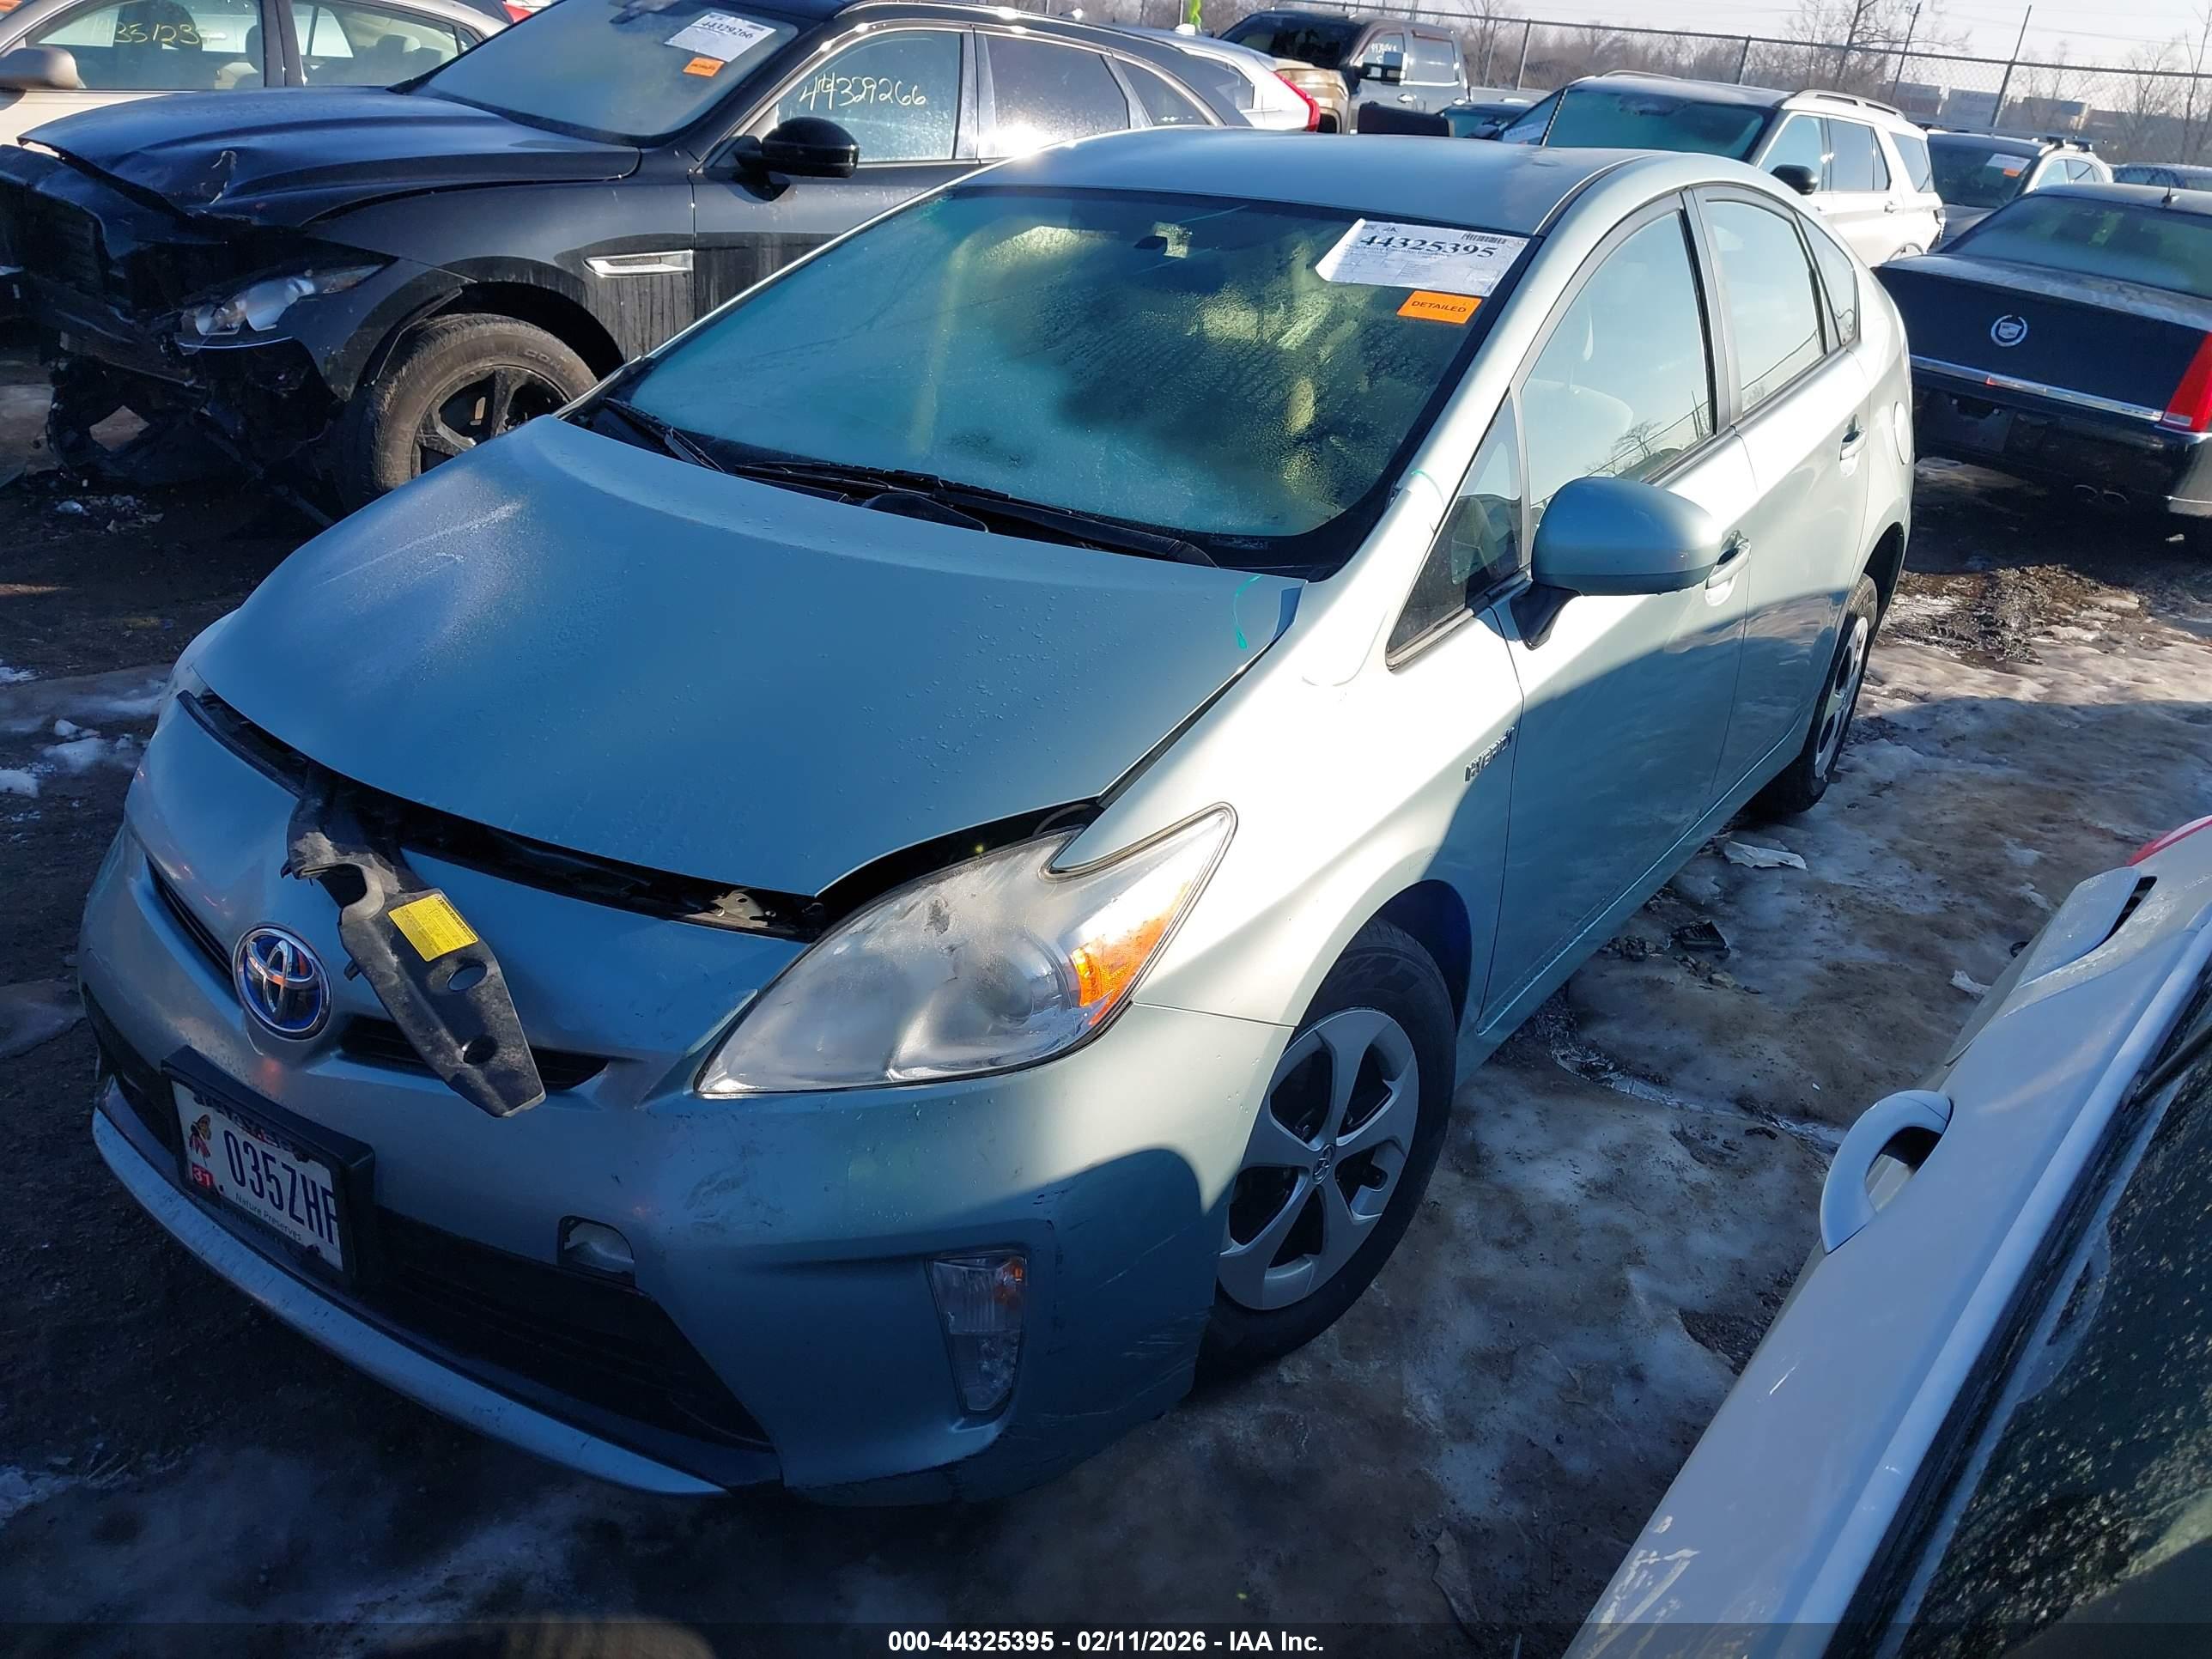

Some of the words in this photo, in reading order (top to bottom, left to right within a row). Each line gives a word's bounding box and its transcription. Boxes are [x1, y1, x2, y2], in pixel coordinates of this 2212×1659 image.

[799, 72, 927, 111] 44329266
[1360, 235, 1498, 258] 44325395
[1411, 301, 1467, 313] DETAILED
[193, 1167, 211, 1187] 31
[235, 1192, 262, 1218] Nature
[264, 1209, 302, 1242] Preserves
